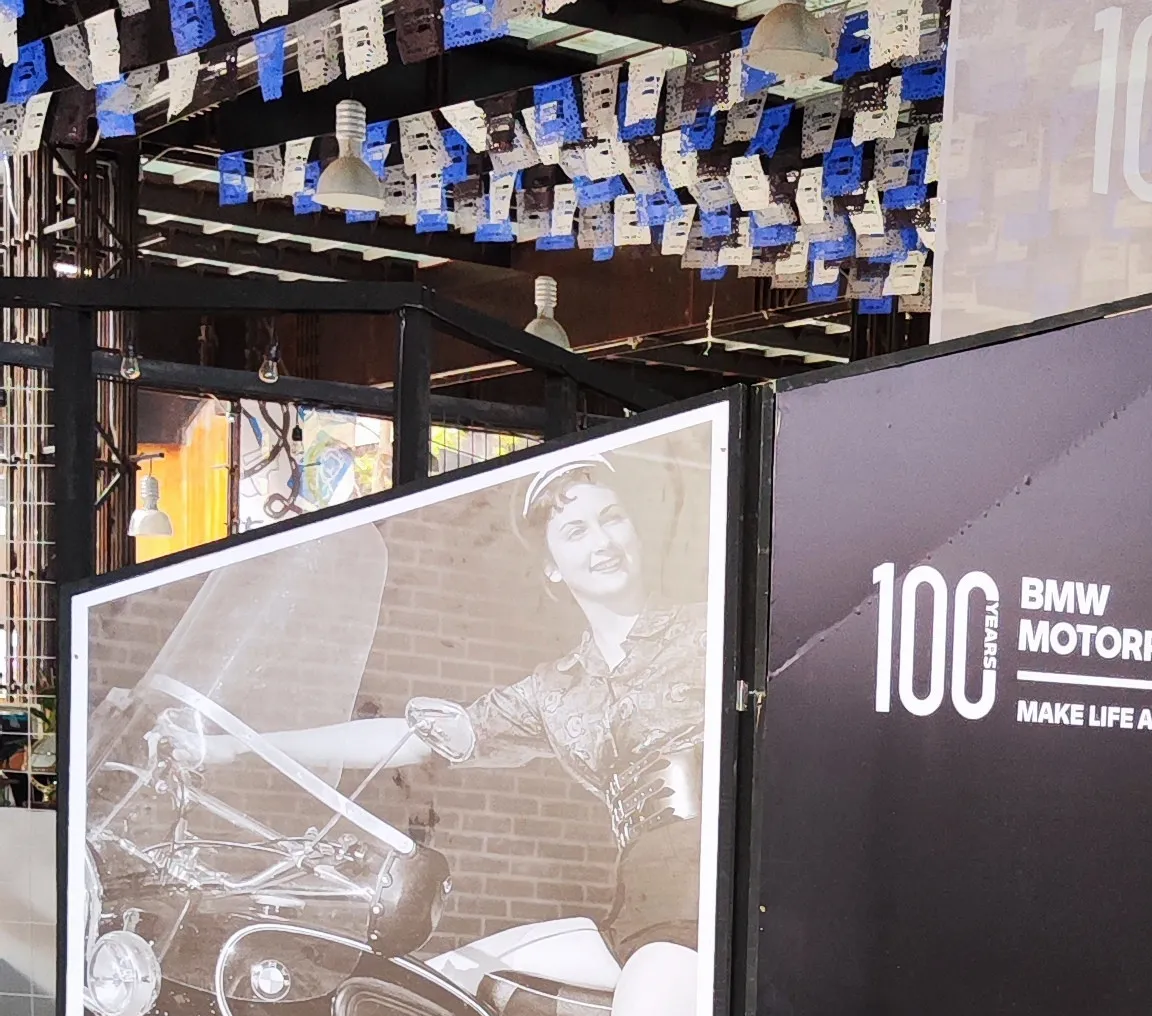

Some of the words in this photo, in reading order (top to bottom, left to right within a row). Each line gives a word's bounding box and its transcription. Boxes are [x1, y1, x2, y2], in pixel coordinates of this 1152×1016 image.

[1020, 576, 1111, 617] BMW
[872, 562, 999, 720] 100
[983, 600, 1000, 671] YEARS
[1016, 699, 1084, 726] MAKE
[1088, 704, 1134, 729] LIFE
[1137, 708, 1152, 730] A
